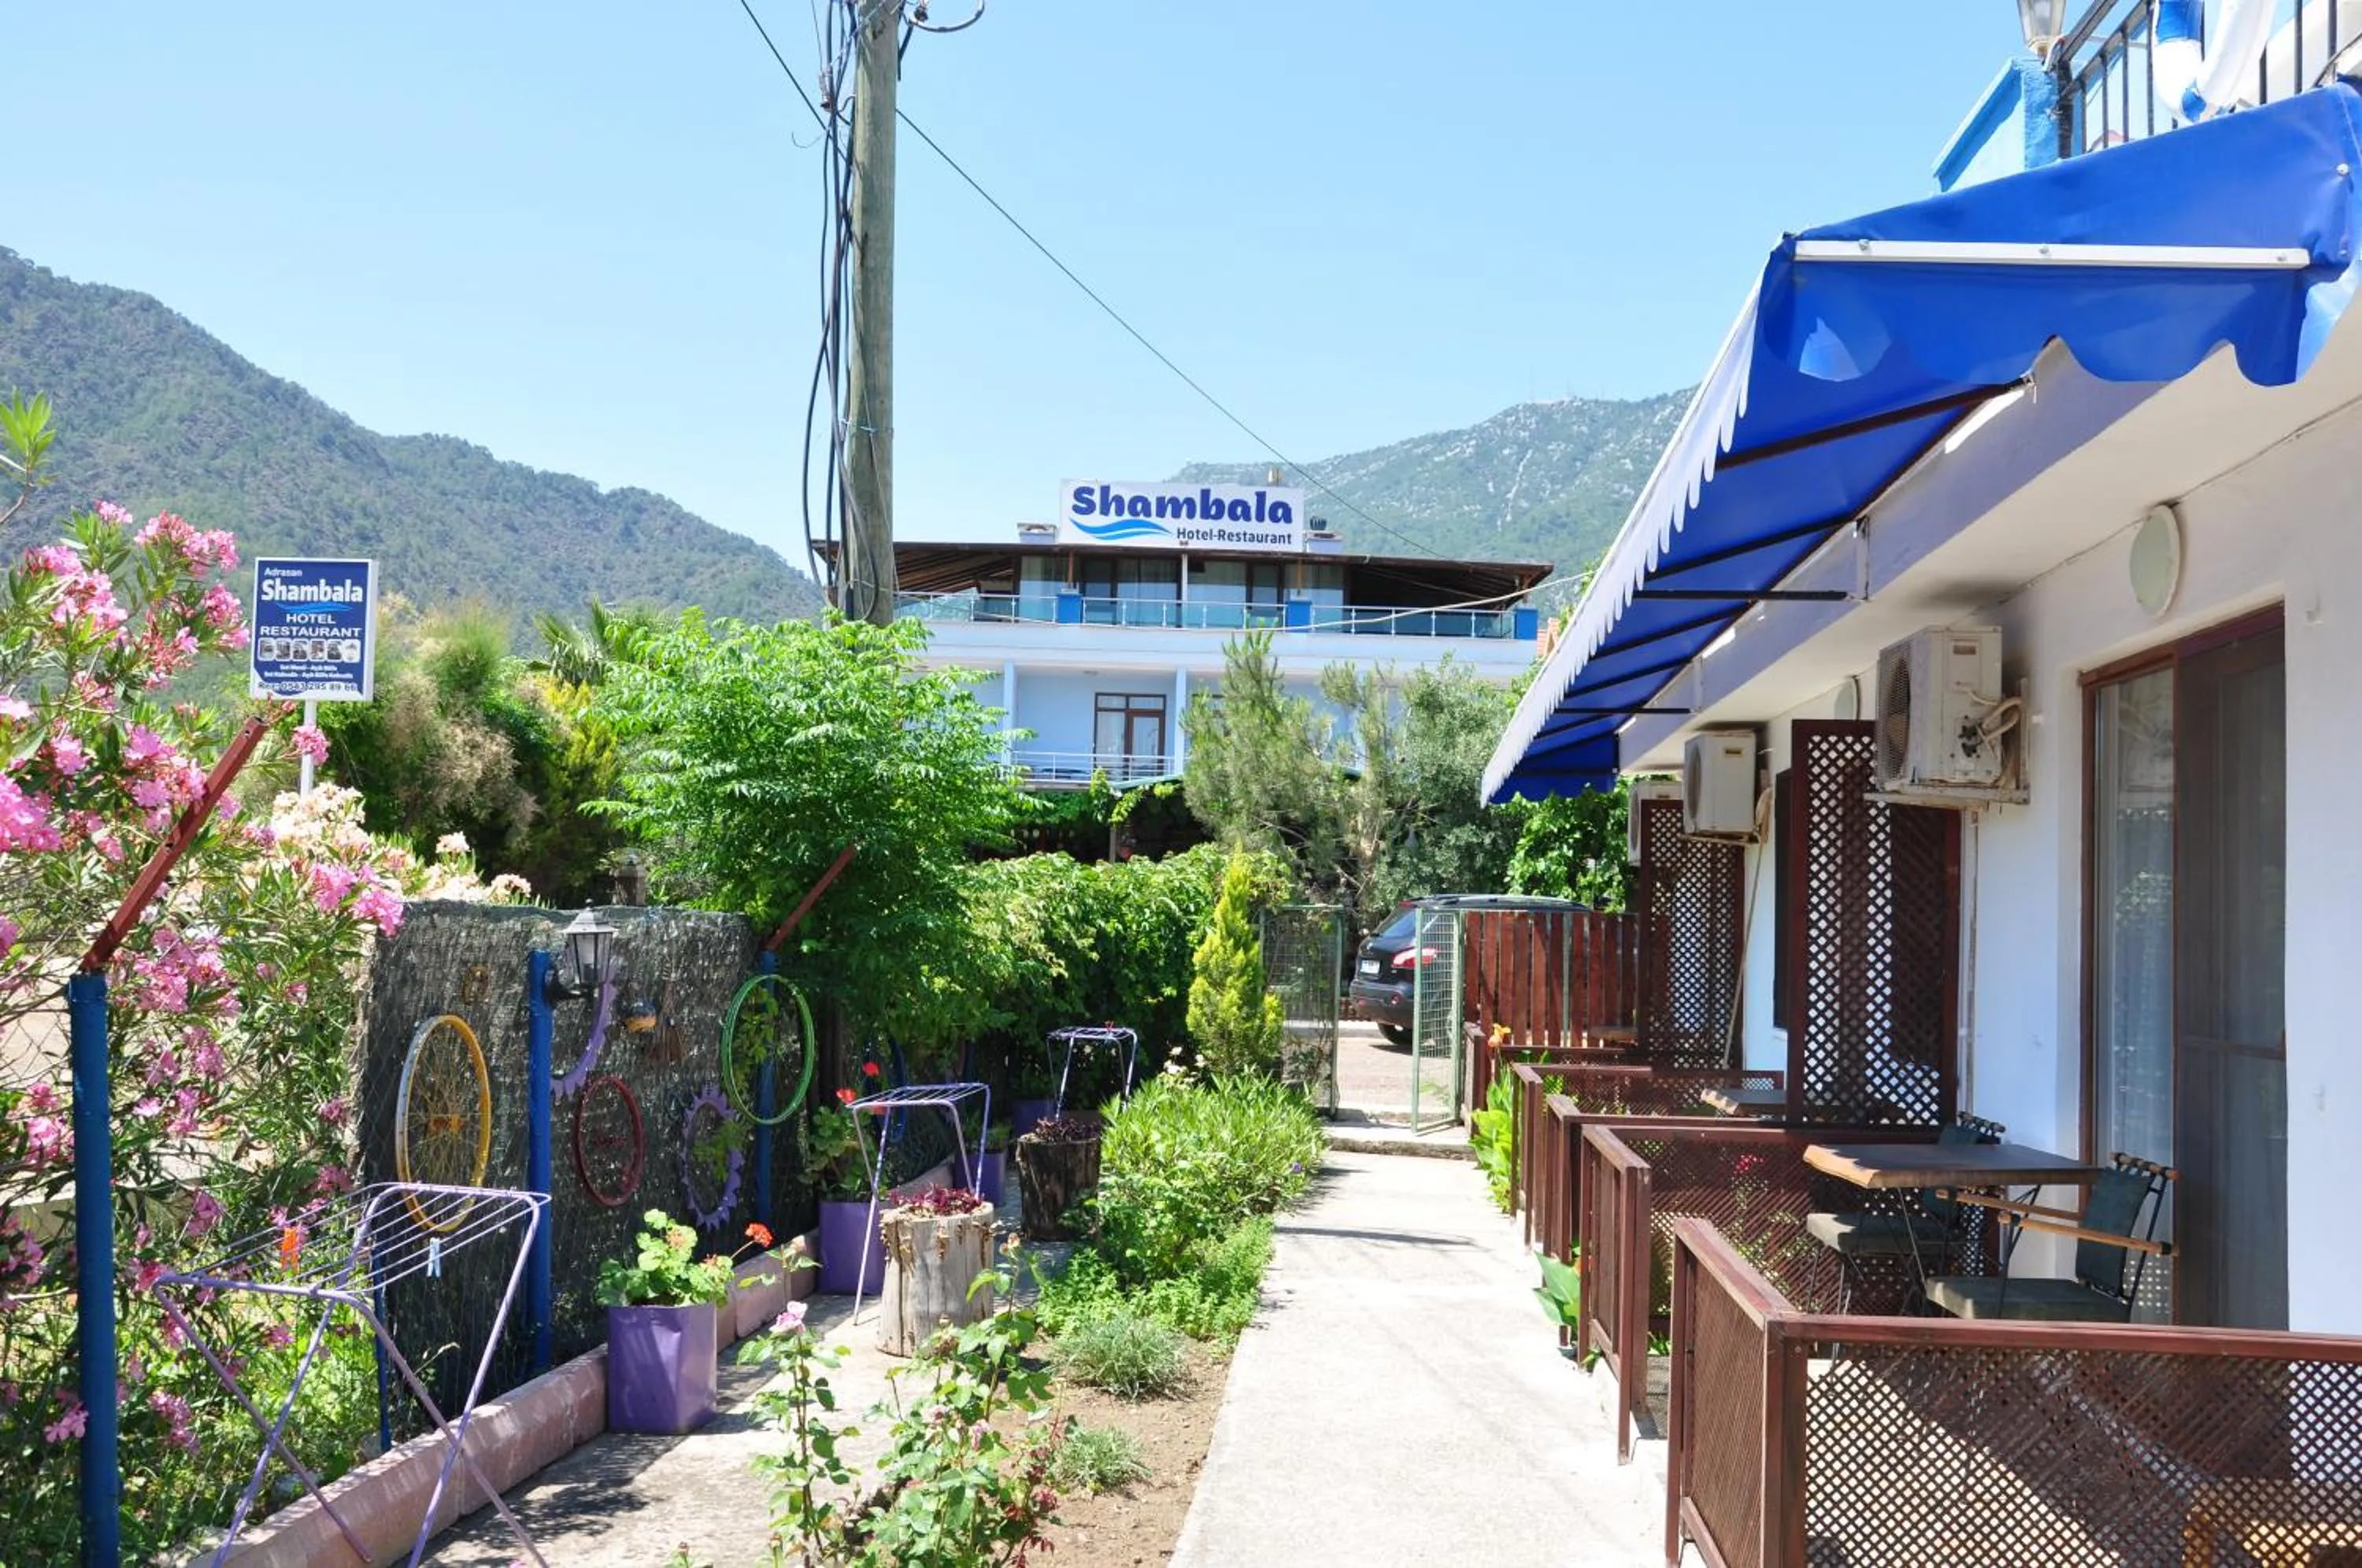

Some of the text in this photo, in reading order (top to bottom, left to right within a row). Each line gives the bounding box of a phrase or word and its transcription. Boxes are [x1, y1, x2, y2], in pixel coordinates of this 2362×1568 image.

[1072, 484, 1293, 524] Shambala
[1176, 527, 1292, 545] Hotel-Restaurant
[265, 567, 303, 577] Adrasan
[261, 578, 363, 603] Shambala
[286, 613, 336, 624] HOTEL
[260, 626, 362, 638] RESTAURANT
